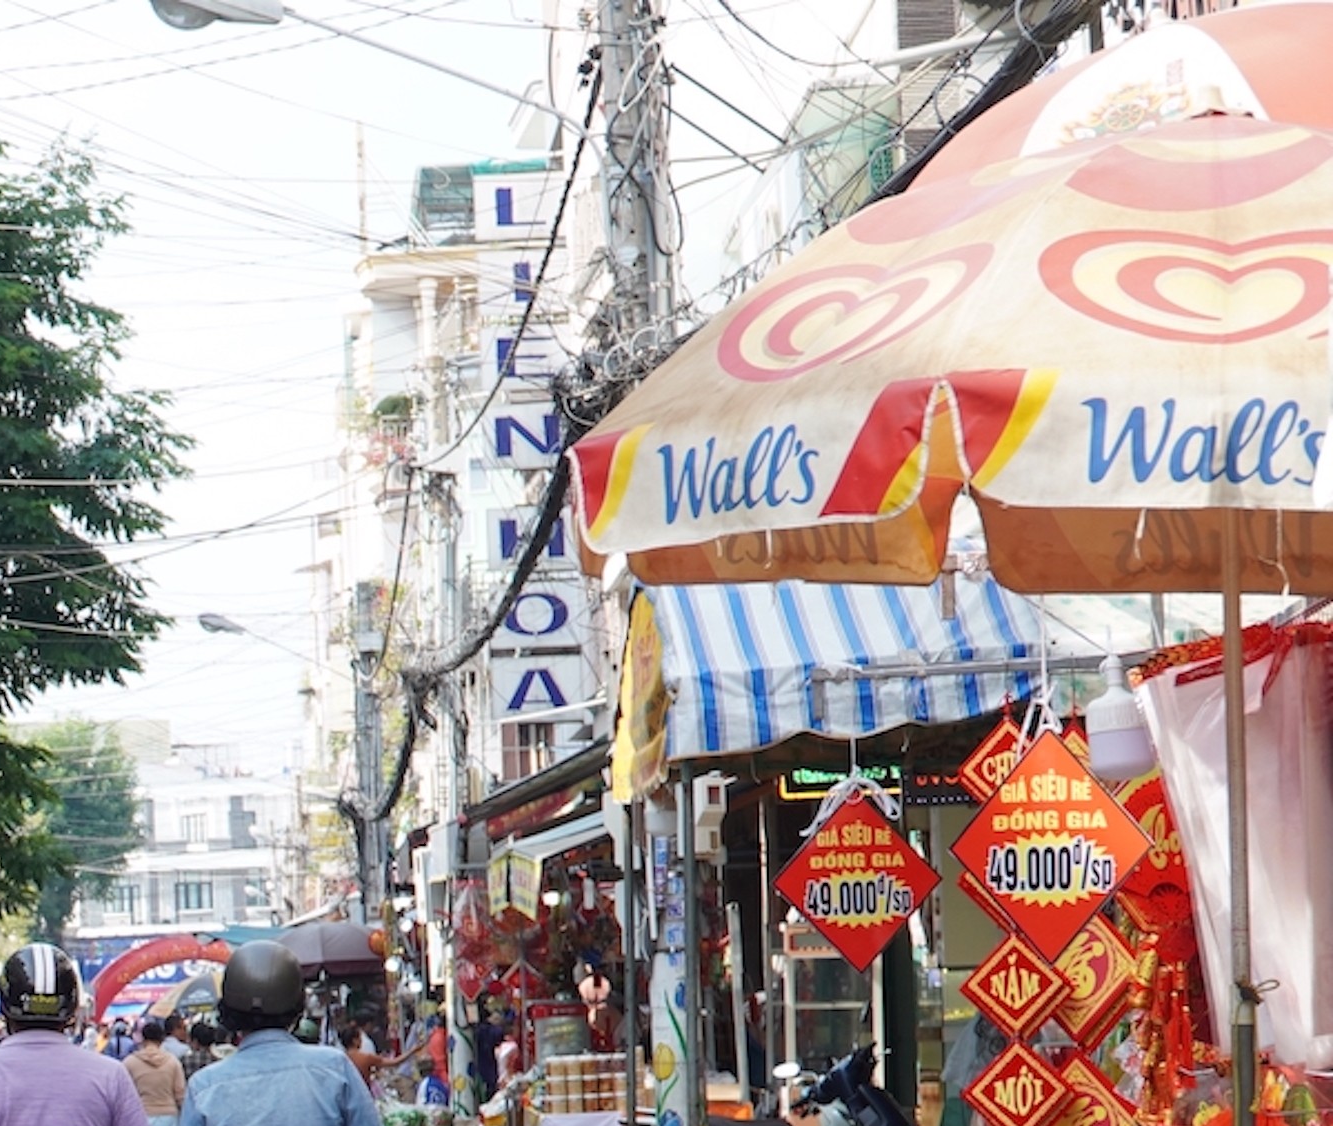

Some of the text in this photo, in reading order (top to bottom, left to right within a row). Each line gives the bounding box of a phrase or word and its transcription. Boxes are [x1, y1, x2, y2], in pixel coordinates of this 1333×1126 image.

[1080, 394, 1328, 488] Wall's
[656, 422, 821, 526] Wall's
[1000, 768, 1093, 804] GIÁ SIÊU RẺ
[817, 824, 839, 848] GIÁ
[842, 819, 872, 846] SIÊU
[1066, 808, 1107, 830] GIÁ
[872, 851, 905, 868] GIÁ
[990, 952, 1041, 1010] NĂM
[993, 1065, 1045, 1117] MỚI
